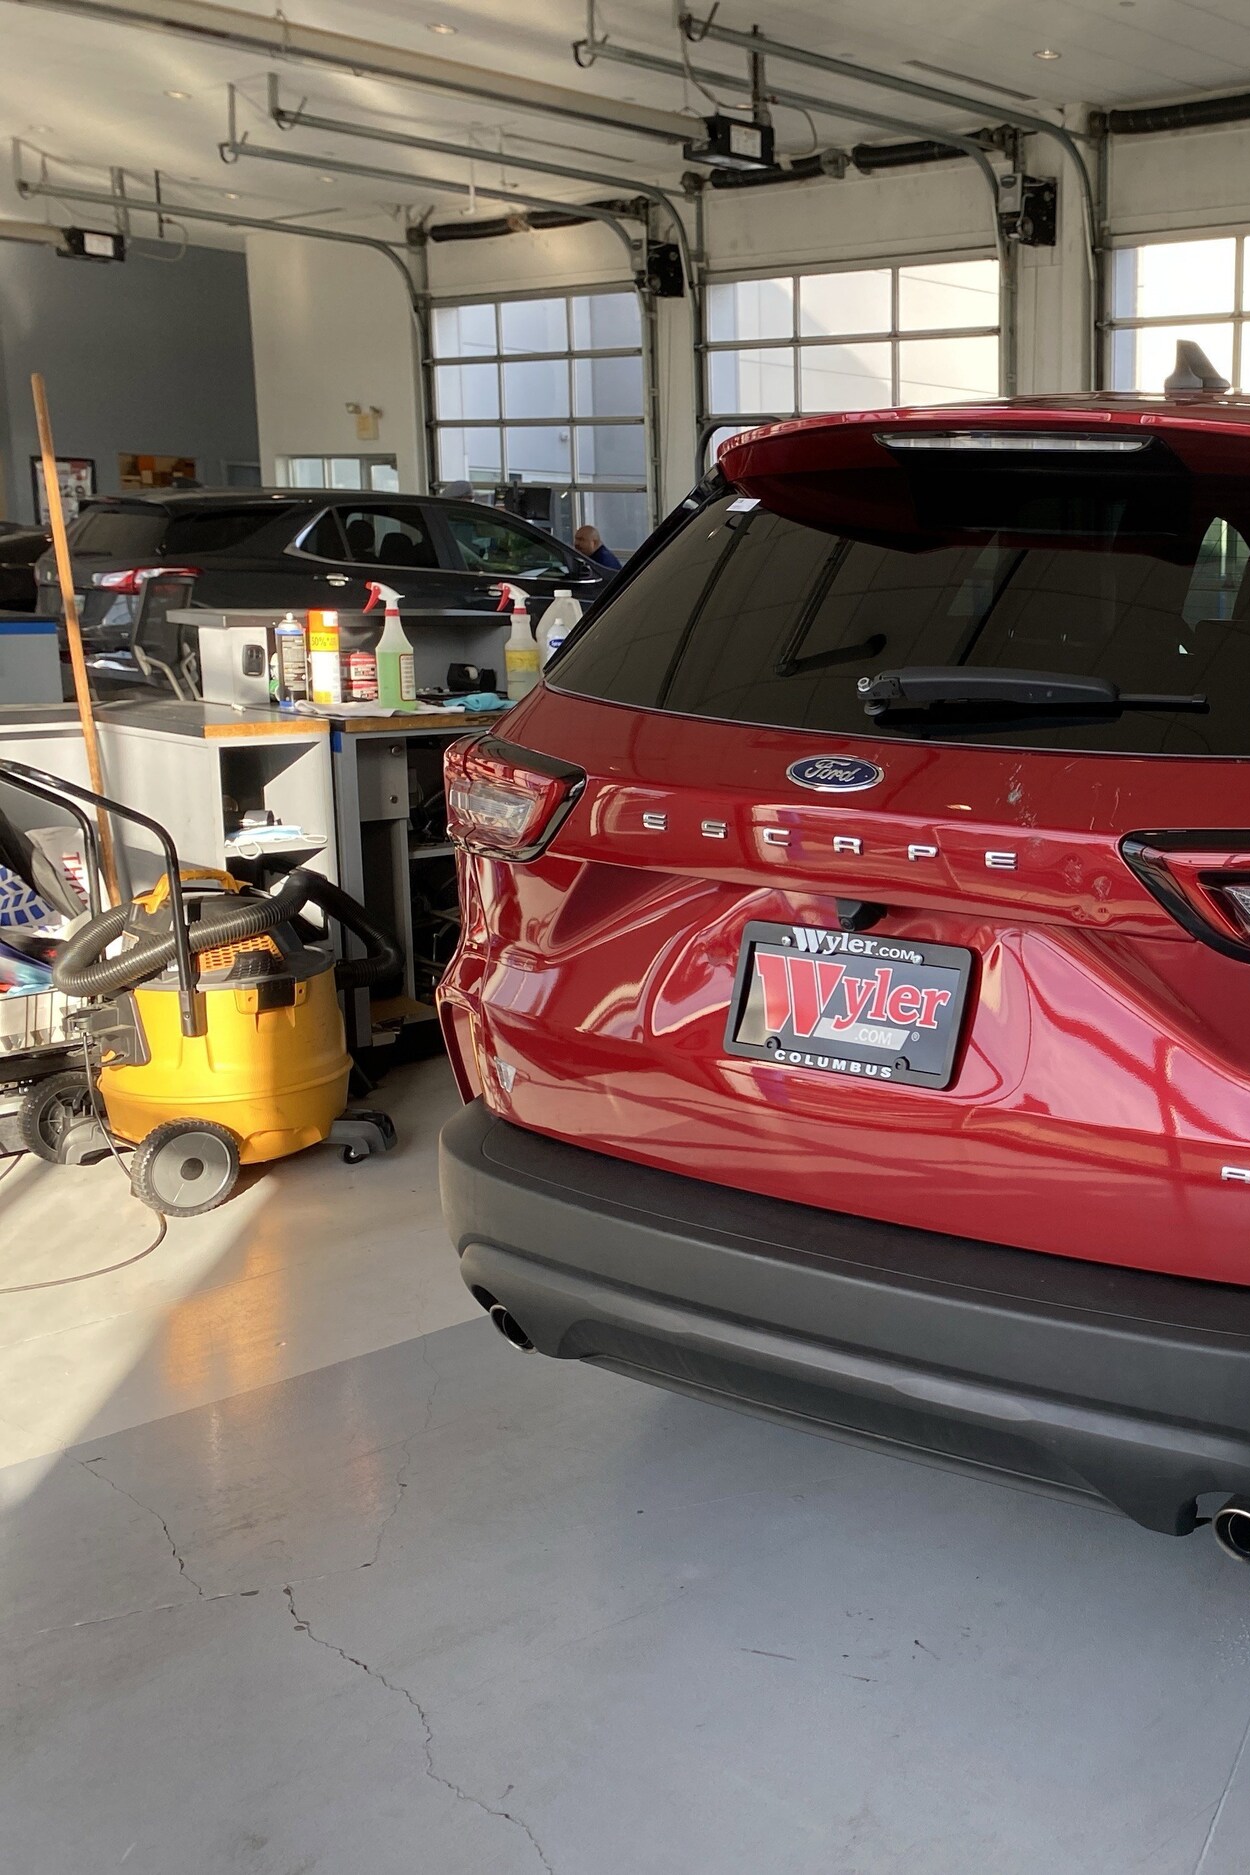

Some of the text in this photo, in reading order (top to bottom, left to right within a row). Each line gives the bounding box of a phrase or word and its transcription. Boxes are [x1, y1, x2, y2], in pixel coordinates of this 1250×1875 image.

[804, 759, 862, 782] Ford
[642, 811, 1018, 870] ESCAPE
[754, 951, 952, 1037] Wyler
[774, 1049, 893, 1078] COLUMBUS
